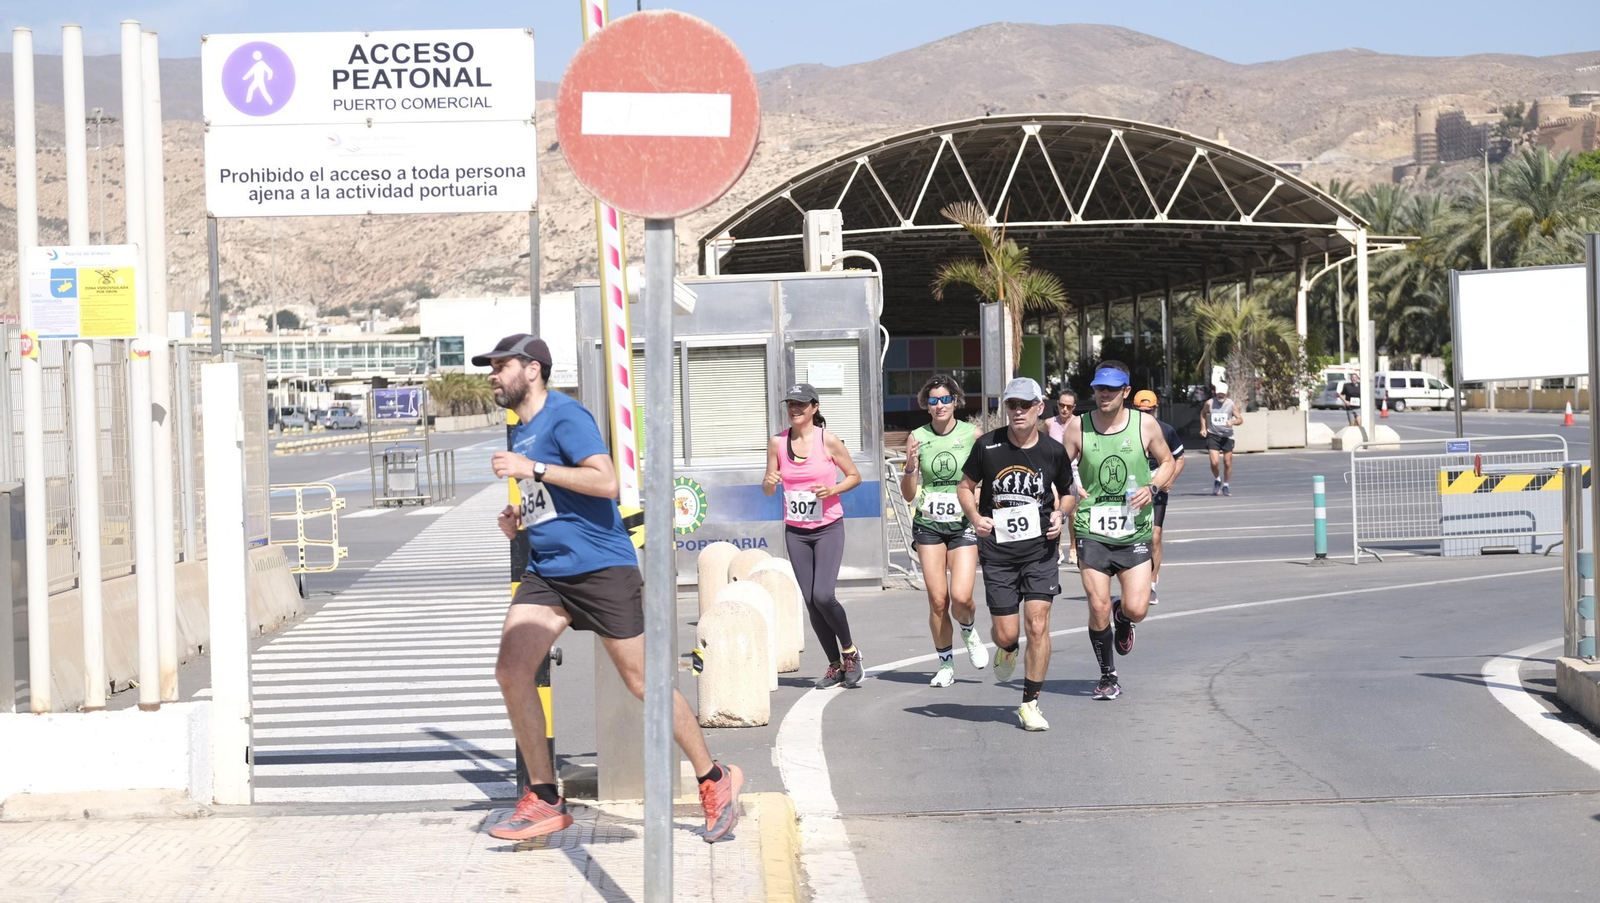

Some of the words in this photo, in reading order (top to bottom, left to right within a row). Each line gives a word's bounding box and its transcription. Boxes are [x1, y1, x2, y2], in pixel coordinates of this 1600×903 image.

[347, 42, 475, 65] ACCESO
[332, 66, 493, 90] PEATONAL
[333, 98, 397, 111] PUERTO
[401, 96, 492, 110] COMERCIAL
[220, 167, 304, 184] Prohibido
[309, 166, 324, 182] el
[329, 169, 392, 182] acceso
[397, 168, 407, 180] a
[411, 164, 450, 181] toda
[455, 166, 526, 183] persona
[248, 188, 295, 205] ajena
[300, 188, 310, 200] a
[316, 184, 330, 200] la
[335, 182, 414, 199] actividad
[419, 182, 498, 202] portuaria
[521, 489, 546, 517] 354
[790, 501, 817, 515] 307
[927, 501, 956, 516] 158
[1006, 516, 1029, 534] 59
[1097, 516, 1128, 531] 157
[676, 536, 769, 551] PORARIA
